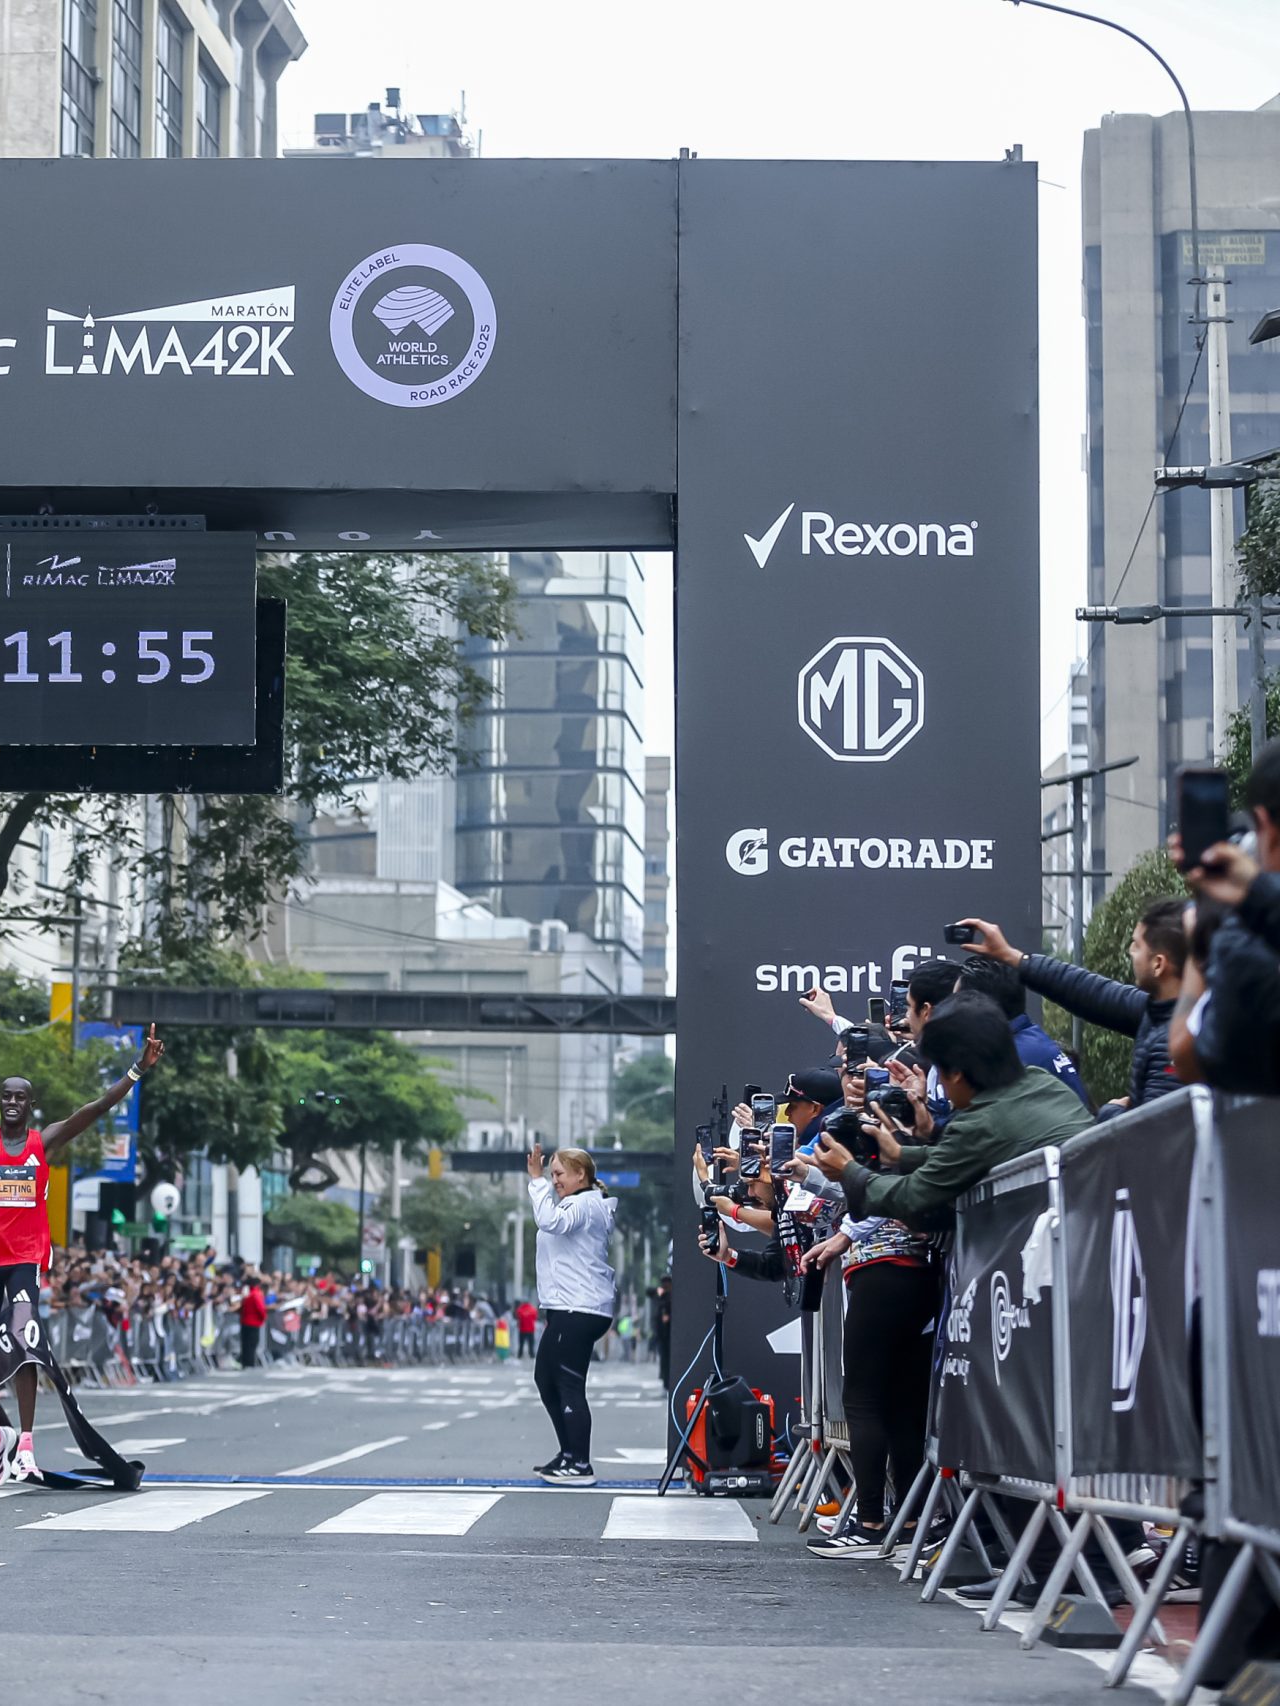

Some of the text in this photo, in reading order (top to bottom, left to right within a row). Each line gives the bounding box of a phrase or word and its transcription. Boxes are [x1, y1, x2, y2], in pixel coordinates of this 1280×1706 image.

[339, 253, 400, 311] ELITE LABEL
[211, 303, 289, 317] MARATÓN
[376, 354, 450, 366] ATHLETICS
[389, 342, 438, 353] WORLD
[410, 324, 490, 401] ROAD RACE 2025
[23, 573, 90, 587] RIMAC
[811, 649, 912, 750] MG
[779, 837, 993, 869] GATORADE
[756, 962, 882, 993] smart
